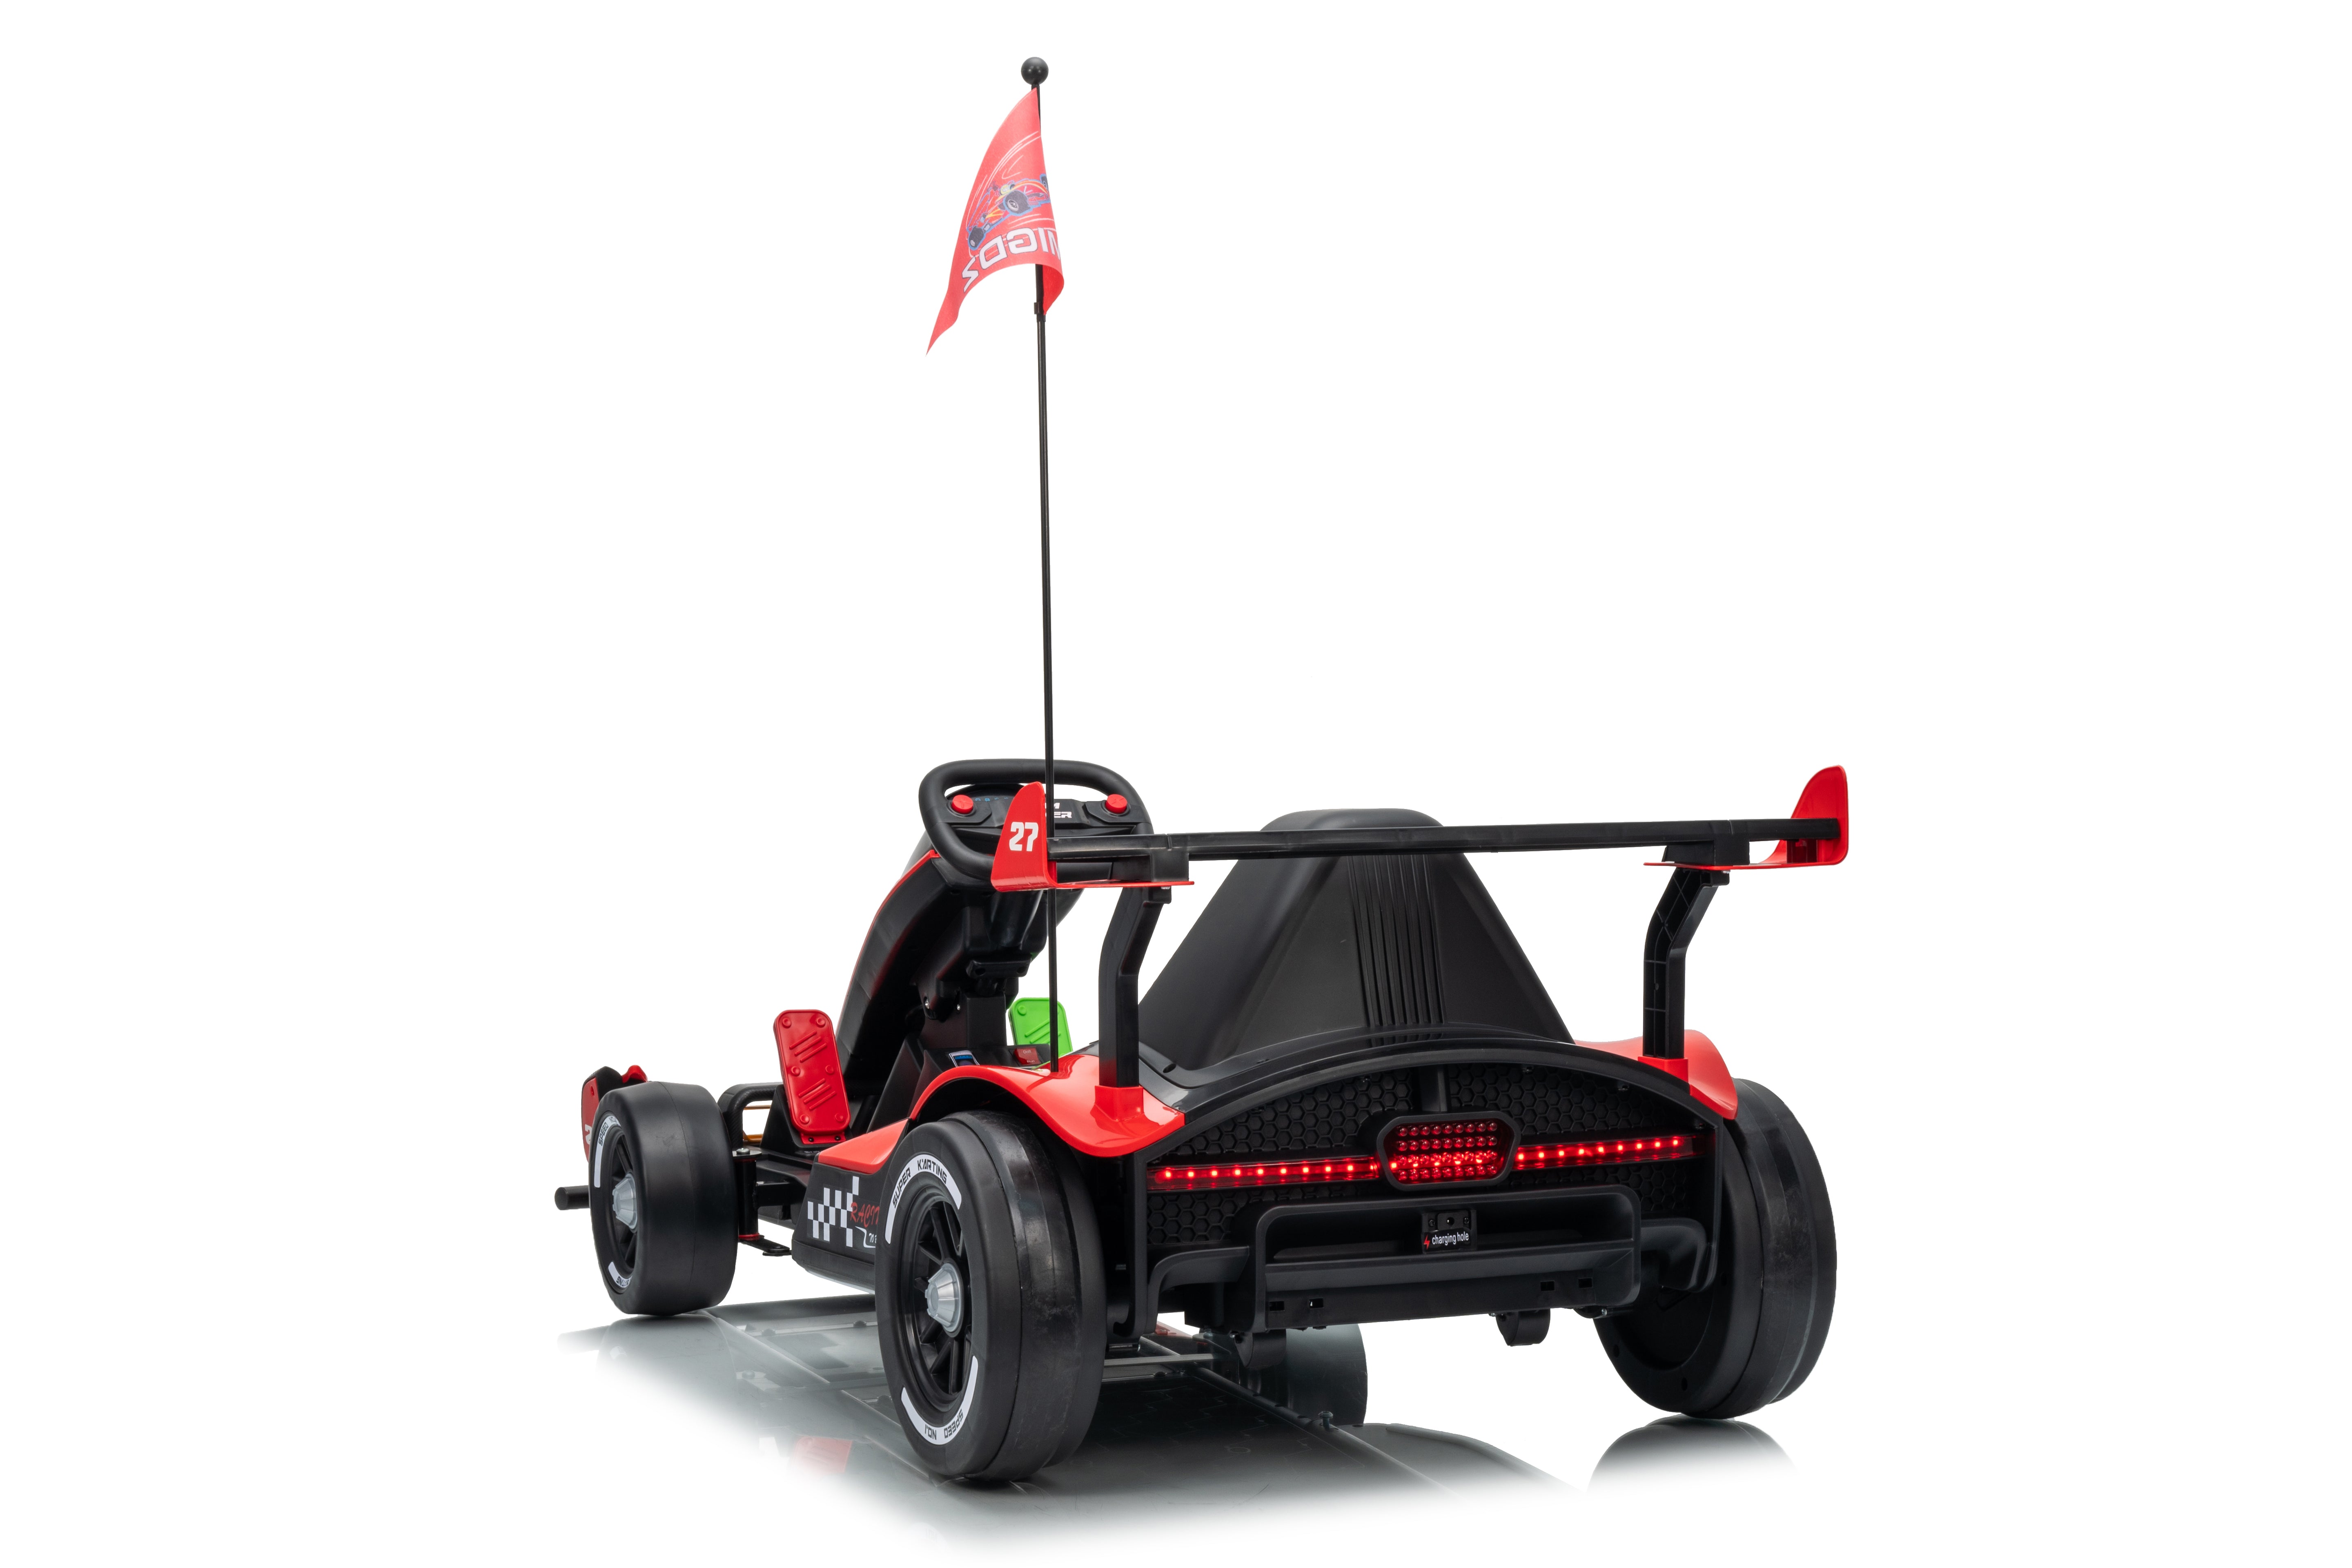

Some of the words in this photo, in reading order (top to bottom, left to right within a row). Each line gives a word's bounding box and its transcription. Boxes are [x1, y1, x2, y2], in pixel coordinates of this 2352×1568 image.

[1009, 822, 1039, 851] 27
[598, 1122, 609, 1146] SPEED
[893, 1167, 911, 1209] SUPER
[1432, 1233, 1456, 1246] charging
[1457, 1231, 1469, 1242] hole
[944, 1408, 963, 1439] SPEED
